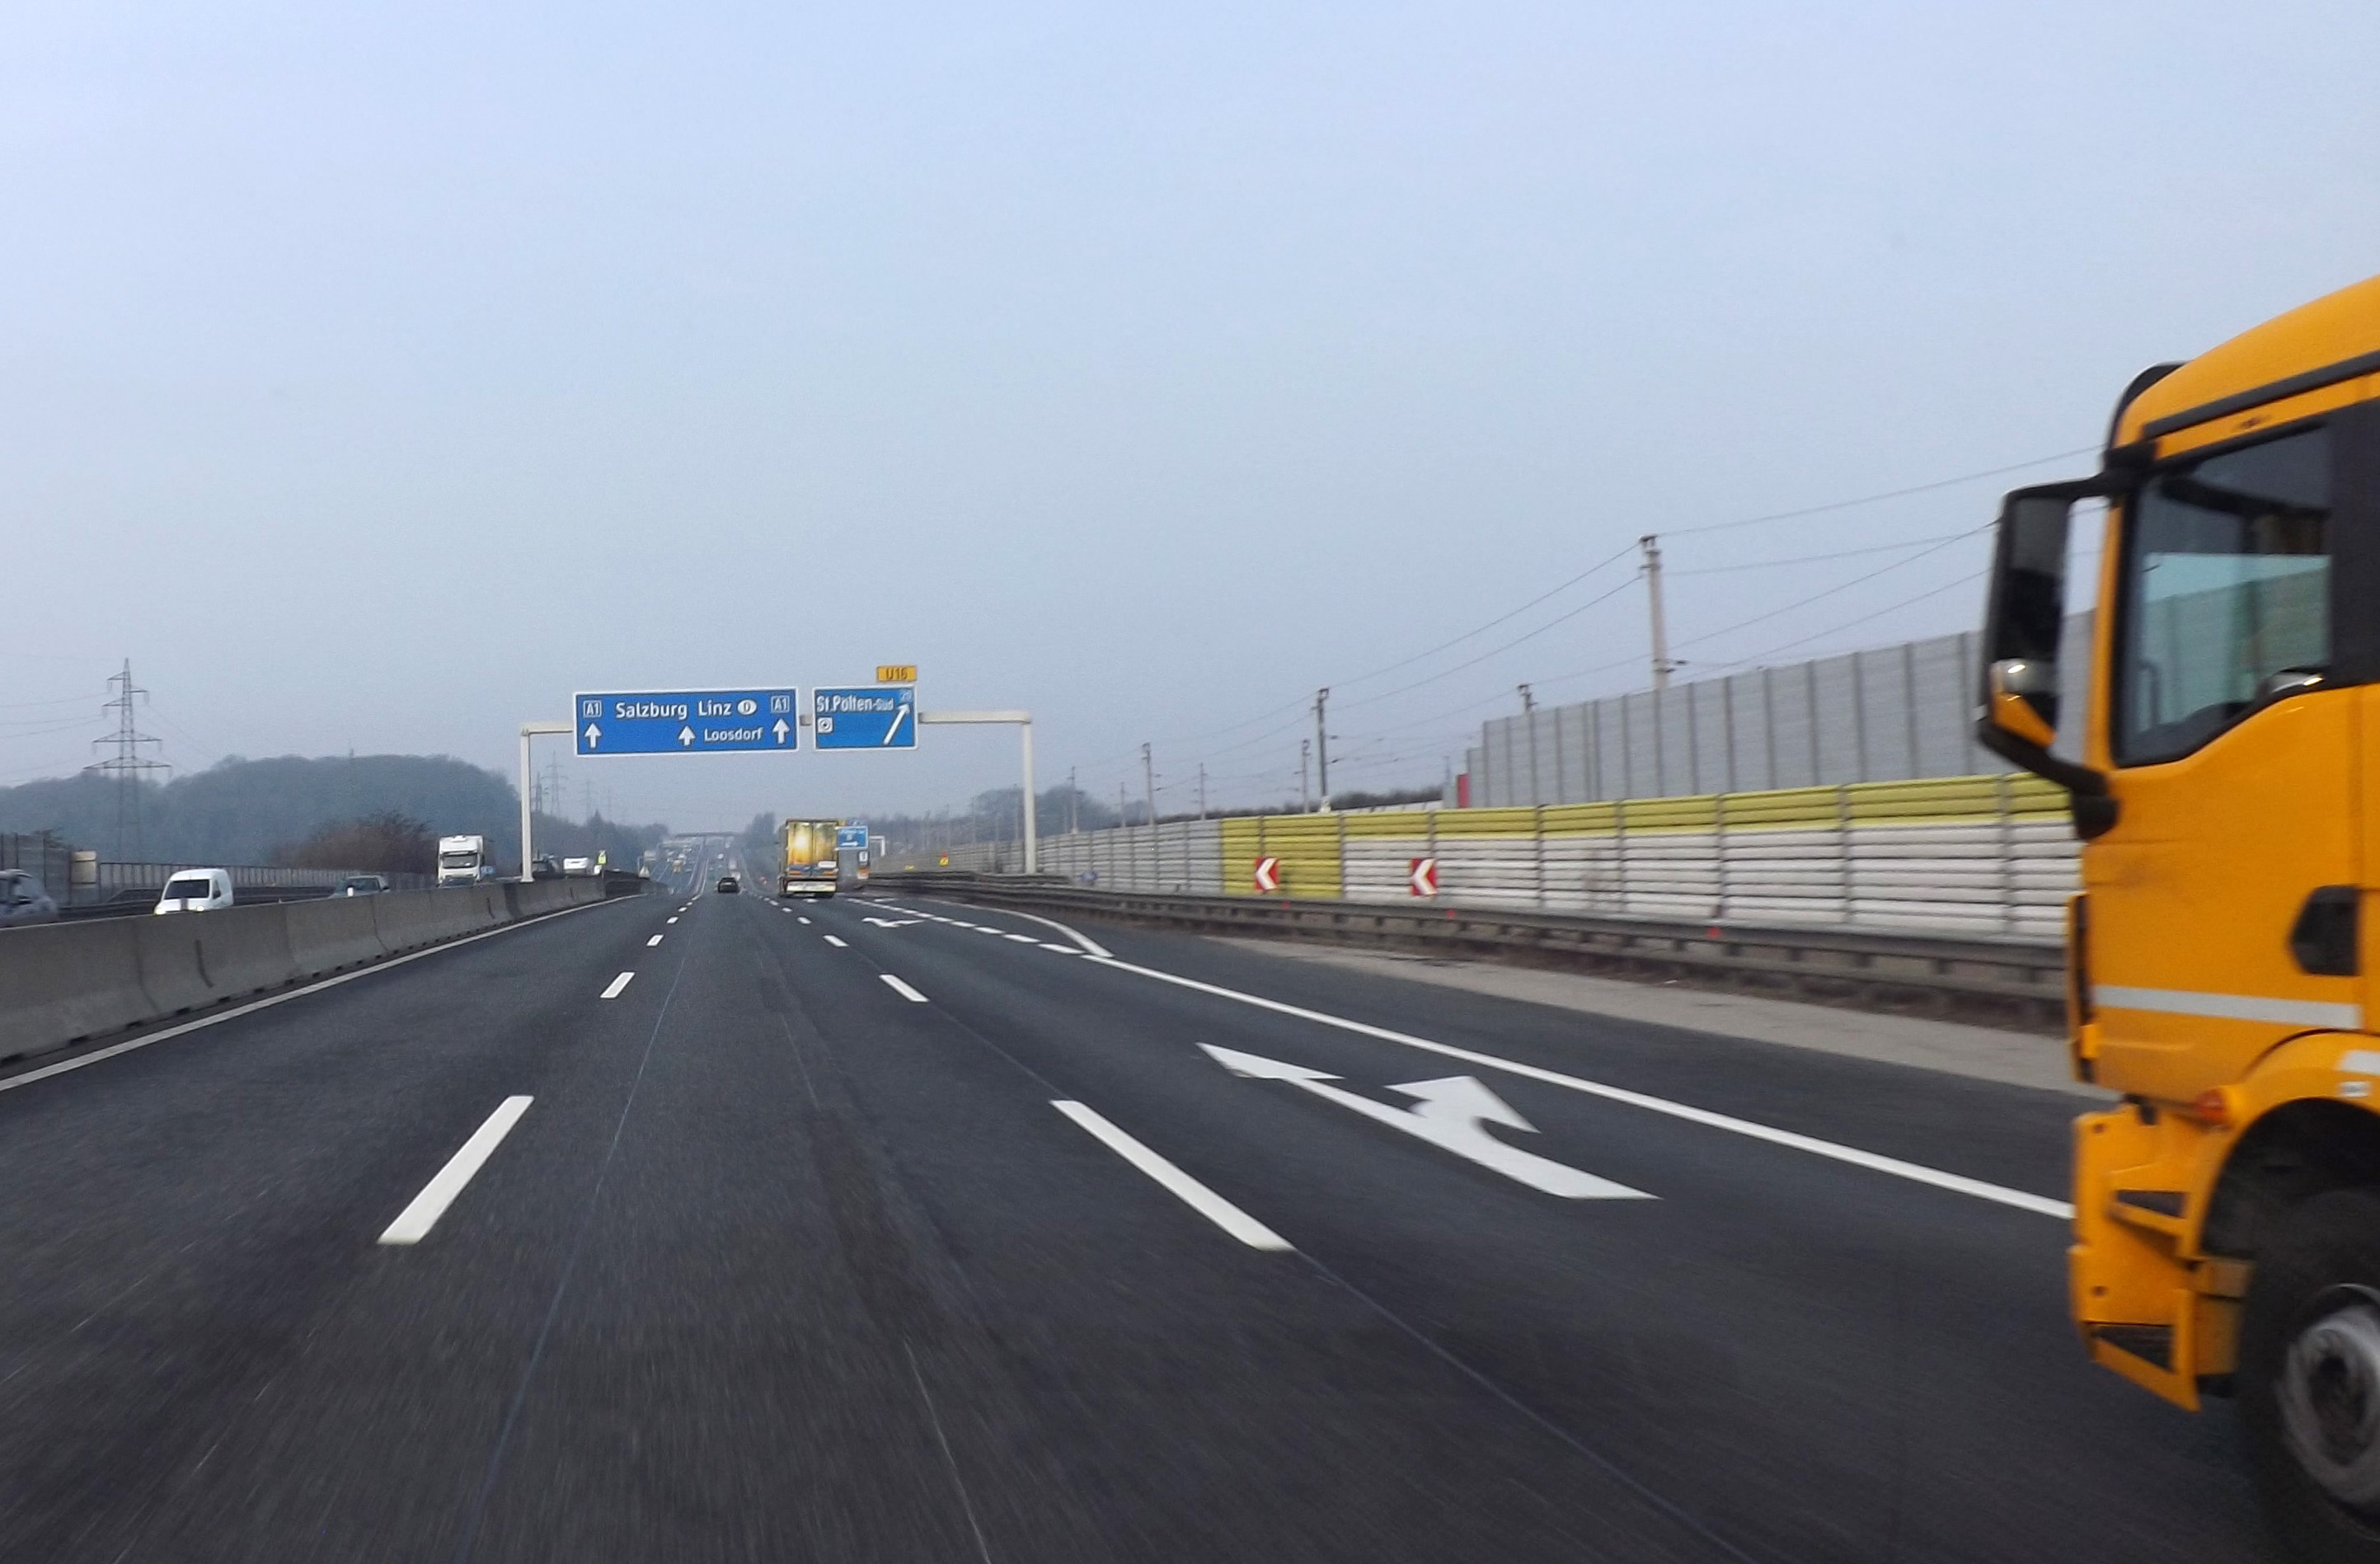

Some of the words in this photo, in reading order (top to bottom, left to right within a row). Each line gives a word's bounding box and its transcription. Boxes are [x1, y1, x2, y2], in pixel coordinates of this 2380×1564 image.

[586, 702, 599, 716] A1
[615, 701, 688, 720] Salzburg
[697, 700, 732, 716] Linz
[774, 697, 787, 711] A1
[704, 726, 763, 741] Loosdorf
